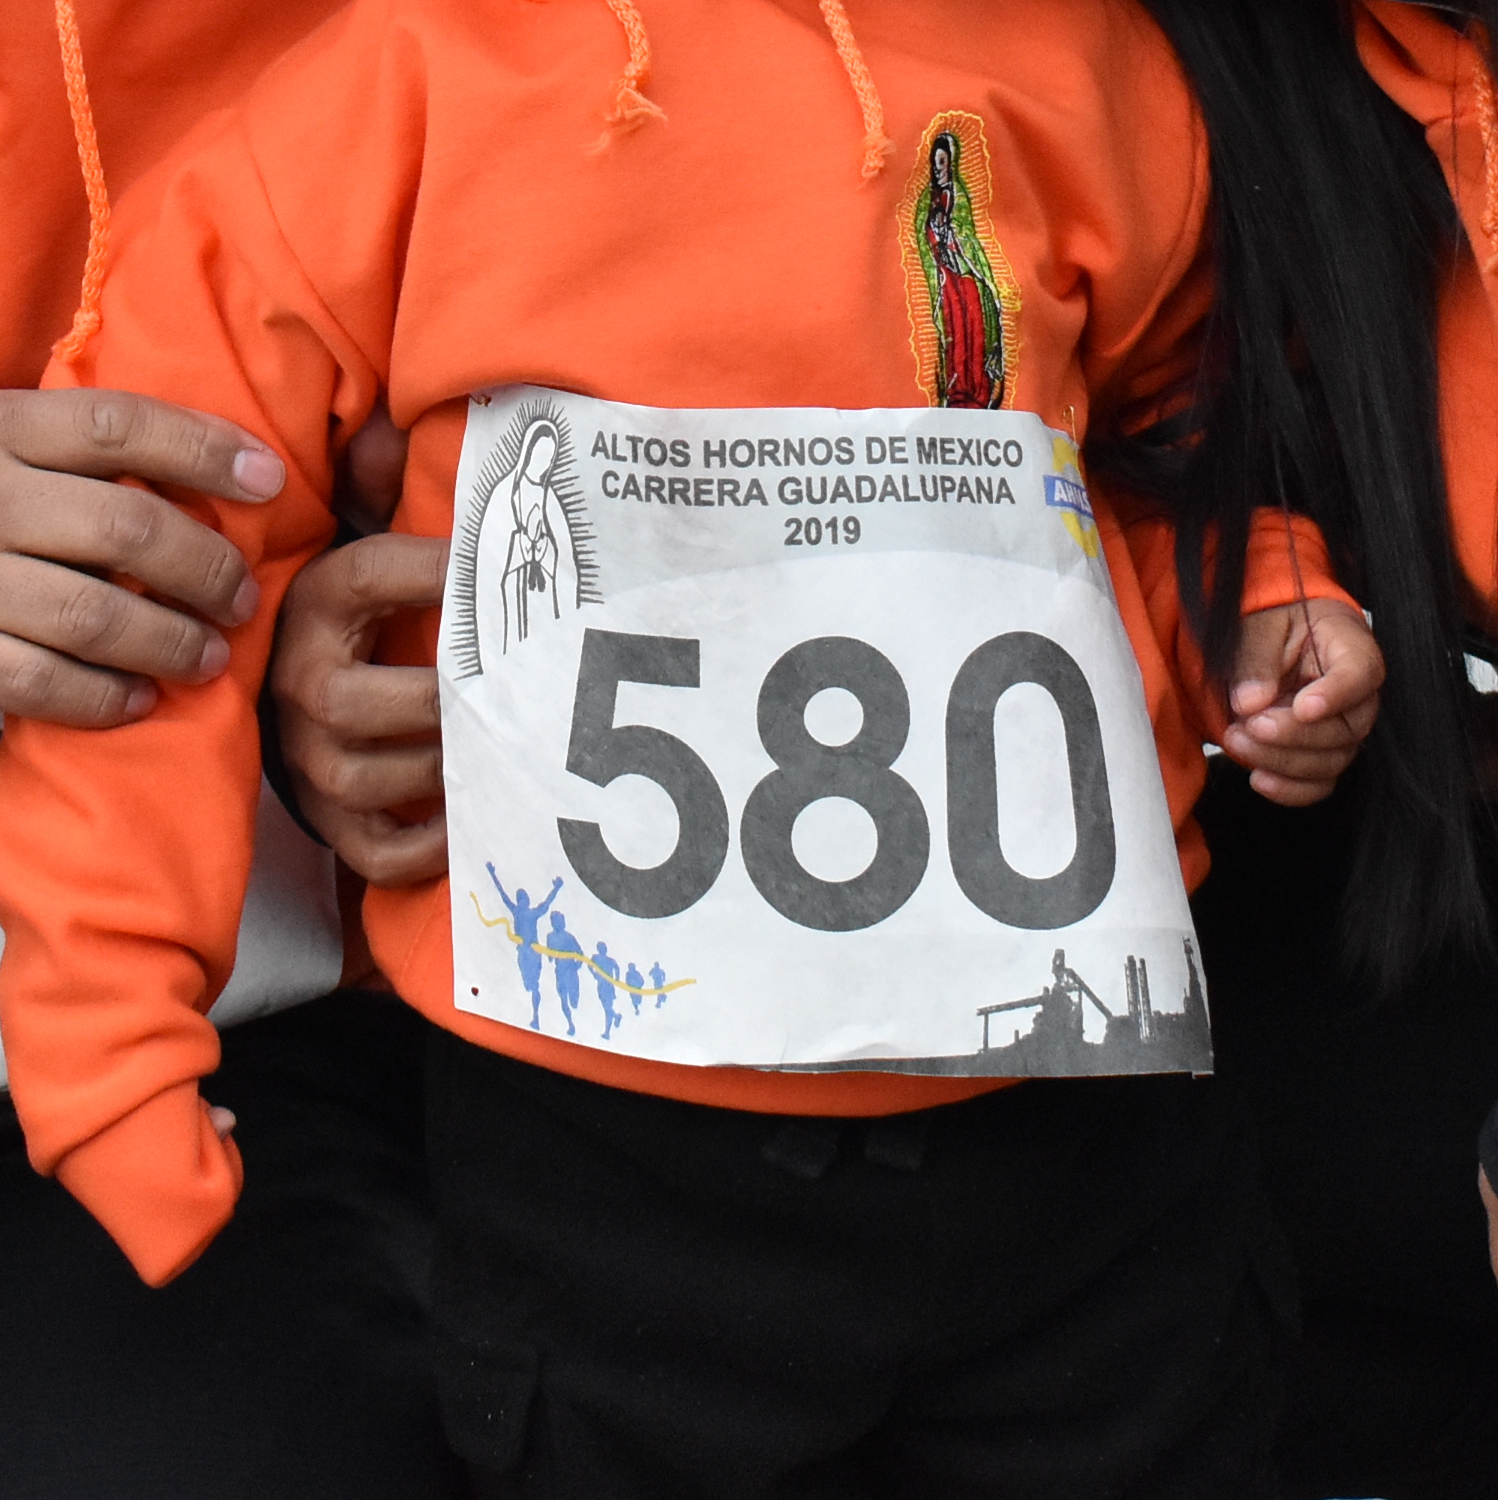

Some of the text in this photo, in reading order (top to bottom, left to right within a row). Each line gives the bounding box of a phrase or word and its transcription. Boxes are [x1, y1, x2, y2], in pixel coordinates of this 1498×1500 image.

[590, 430, 1024, 469] ALTOS HORNOS DE MEXICO
[601, 470, 1017, 507] CARRERA GUADALUPANA
[783, 515, 862, 546] 2019
[555, 627, 1117, 933] 580
